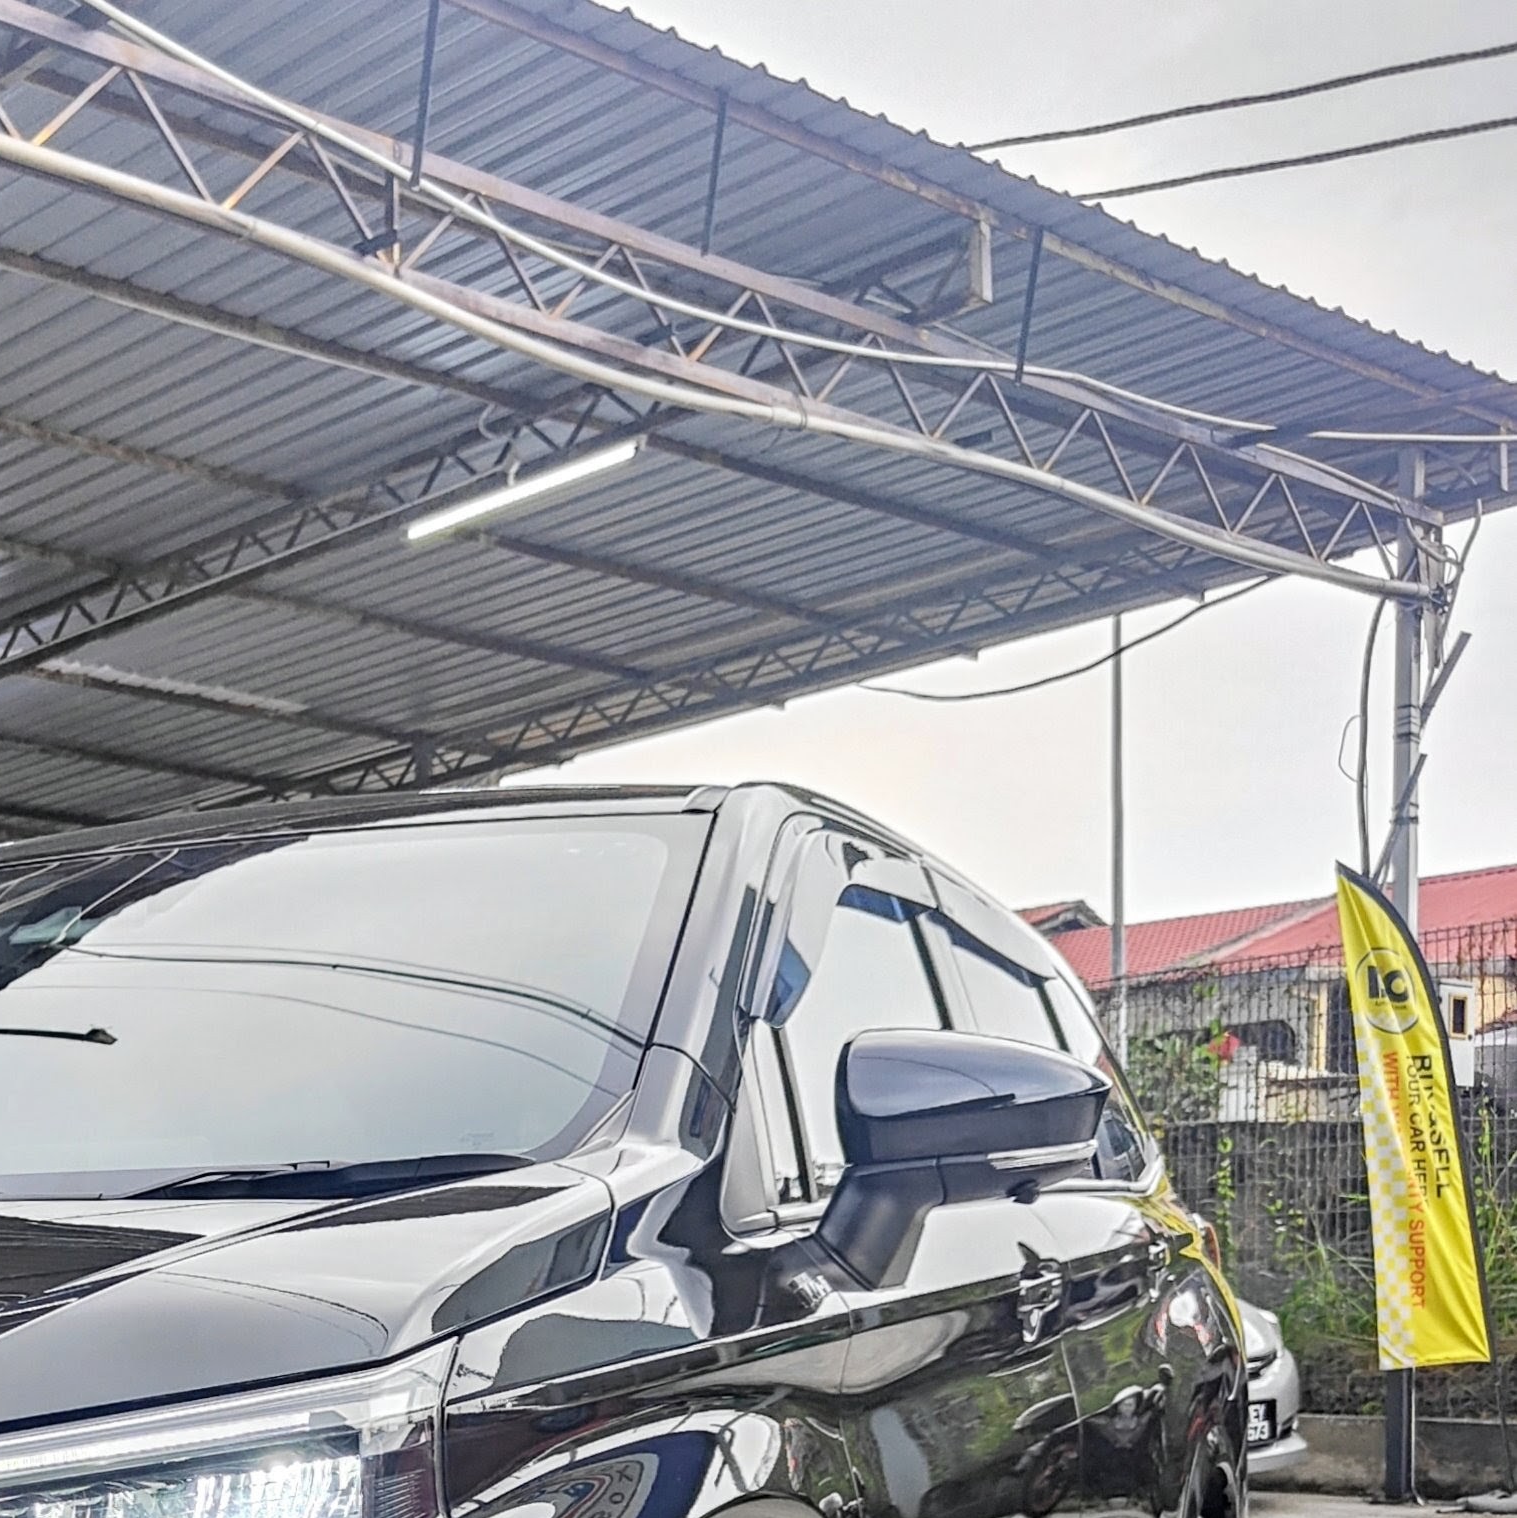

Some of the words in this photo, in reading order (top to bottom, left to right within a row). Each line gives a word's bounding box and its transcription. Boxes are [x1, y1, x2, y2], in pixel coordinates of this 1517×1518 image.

[1382, 1051, 1400, 1100] WITH
[1406, 1056, 1420, 1107] OUR
[1409, 1112, 1426, 1153] CAR
[1408, 1219, 1426, 1309] SUPPORT
